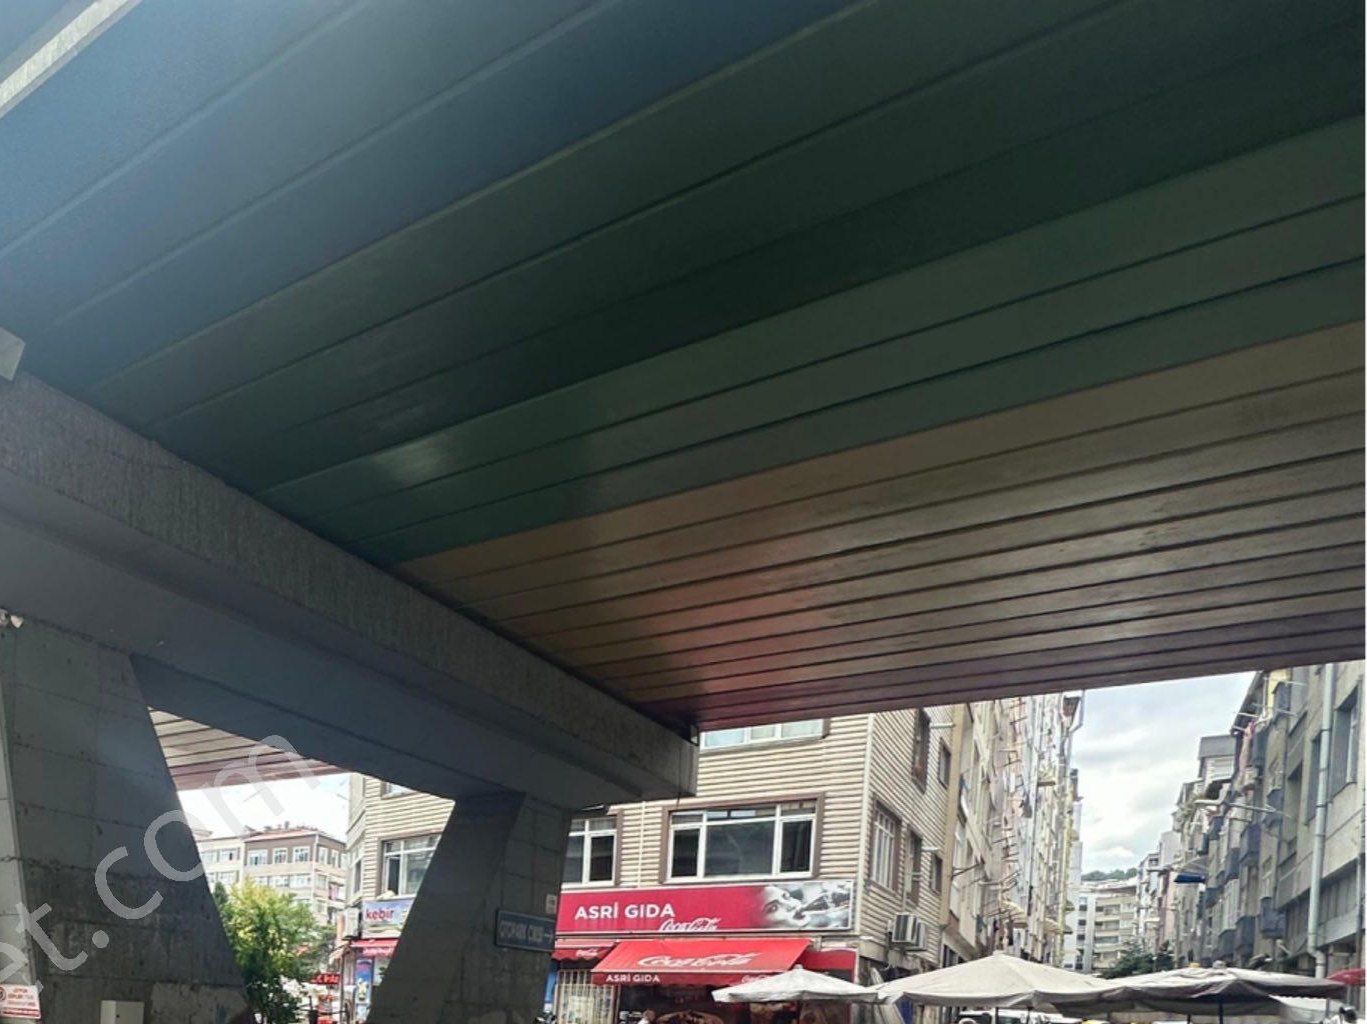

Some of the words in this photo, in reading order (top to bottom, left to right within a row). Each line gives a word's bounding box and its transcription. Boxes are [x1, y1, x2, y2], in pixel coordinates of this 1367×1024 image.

[365, 908, 395, 920] kebir
[574, 902, 619, 920] ASRİ
[624, 903, 676, 919] GIDA
[632, 975, 660, 983] GIDA
